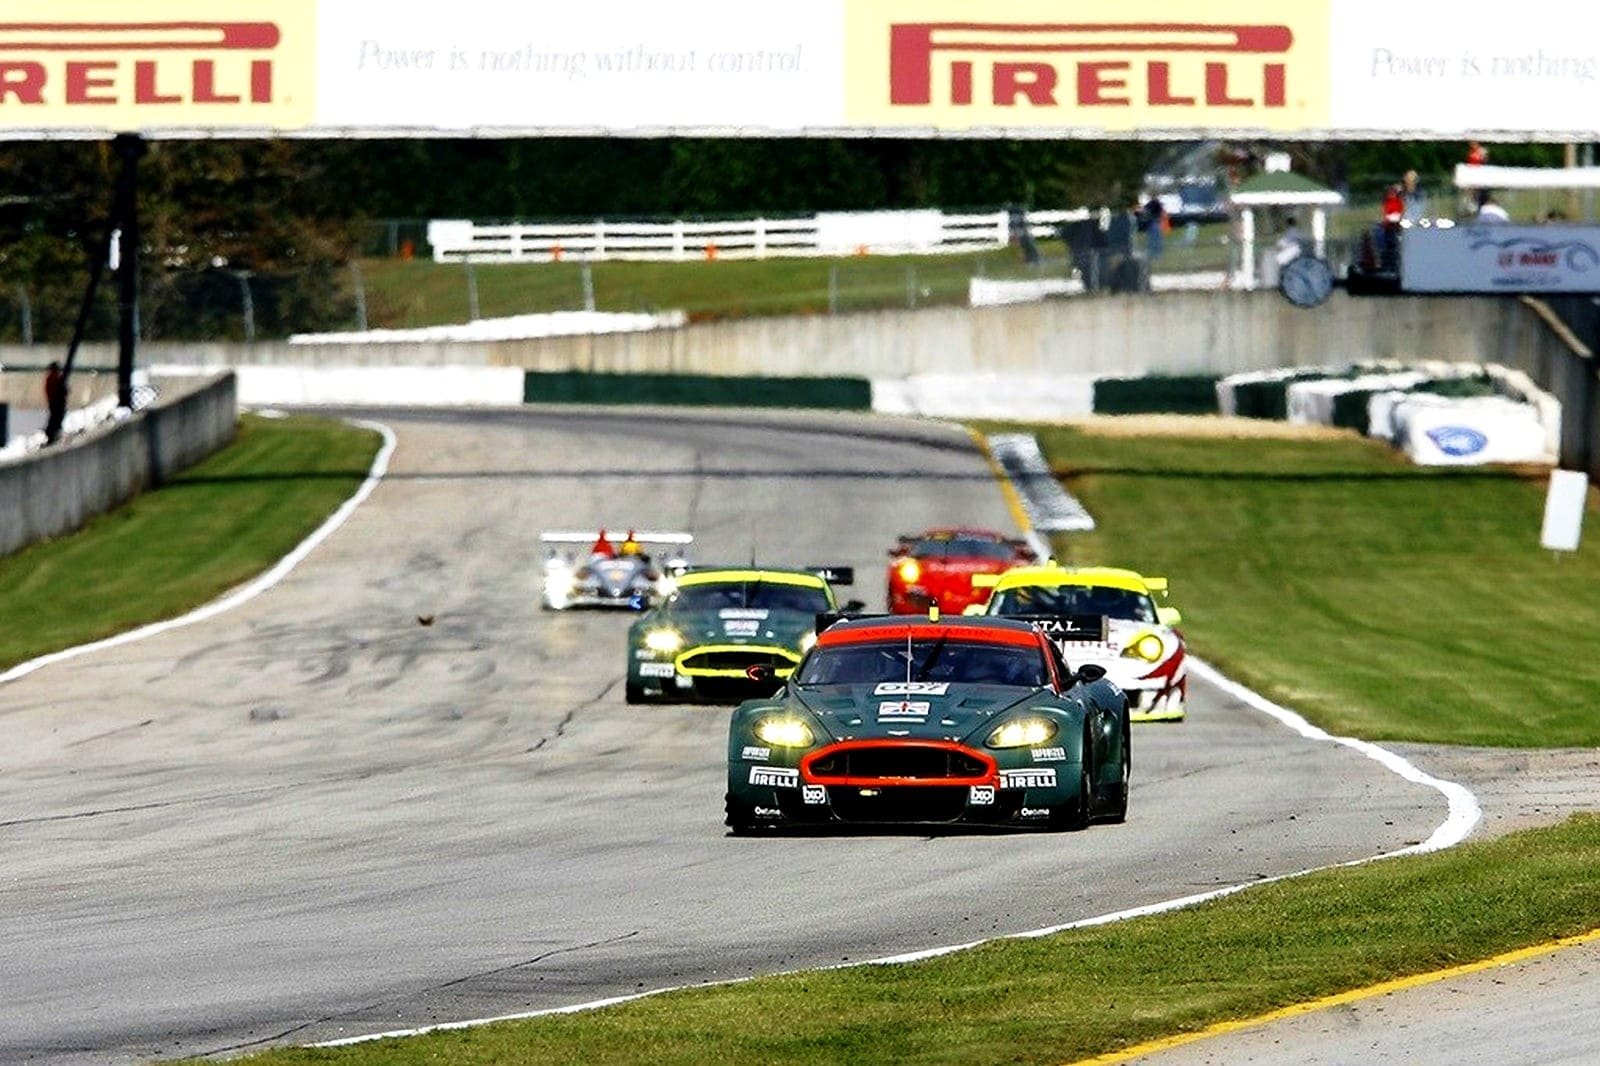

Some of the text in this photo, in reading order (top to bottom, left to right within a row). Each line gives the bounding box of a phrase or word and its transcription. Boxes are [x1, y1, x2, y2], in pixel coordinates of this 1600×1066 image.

[0, 22, 281, 105] RELLI
[357, 39, 438, 71] Power
[447, 43, 470, 71] is
[477, 42, 588, 80] nothing
[594, 42, 696, 73] without
[889, 23, 1293, 108] PIRELLI
[1370, 47, 1597, 88] Power is nothing
[749, 766, 799, 788] PIRELLI
[998, 768, 1057, 788] PIRELLI
